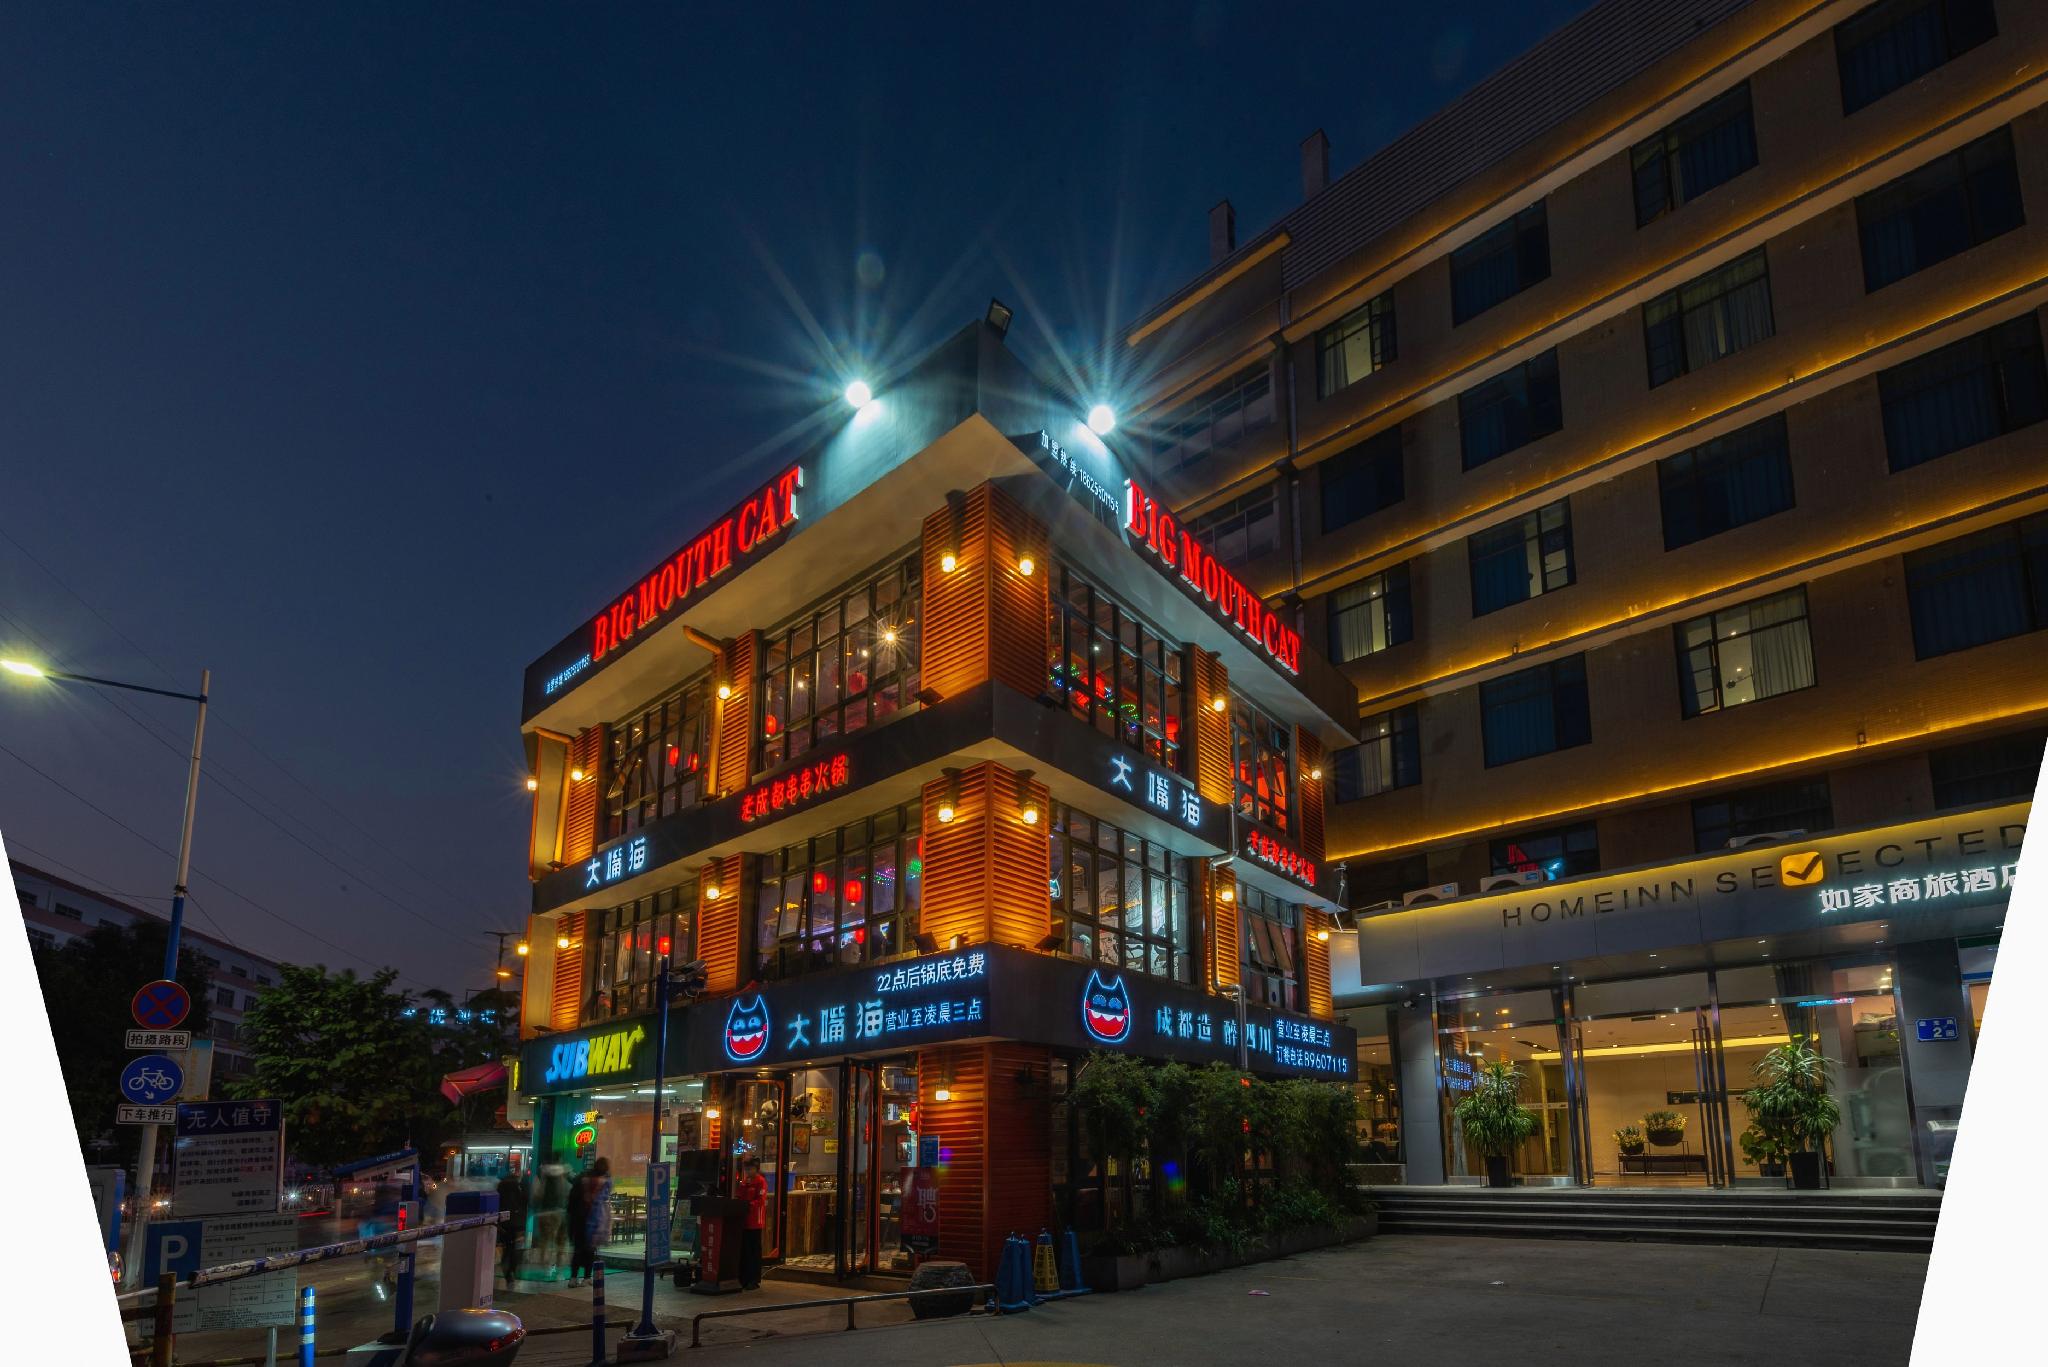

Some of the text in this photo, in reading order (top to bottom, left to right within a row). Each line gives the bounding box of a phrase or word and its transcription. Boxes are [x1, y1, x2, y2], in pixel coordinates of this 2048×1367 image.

[592, 466, 803, 662] BIG MOUTH CAT
[1125, 478, 1301, 676] BIG MOUTH CAT
[1111, 755, 1201, 827] 大嘴猫
[585, 836, 646, 888] 大嘴猫
[1502, 878, 1696, 929] HOMEINN
[876, 952, 986, 993] 22点后锅底免费
[786, 998, 884, 1051] 大嘴猫
[884, 997, 982, 1032] 营业至凌晨三点
[1275, 1018, 1331, 1048] 营业至凌晨三点
[130, 1033, 186, 1047] 拍摄路段
[545, 1024, 646, 1084] SUBWAY
[121, 1108, 174, 1121] 下车推行
[186, 1107, 272, 1130] 无人值守
[159, 1234, 189, 1275] P
